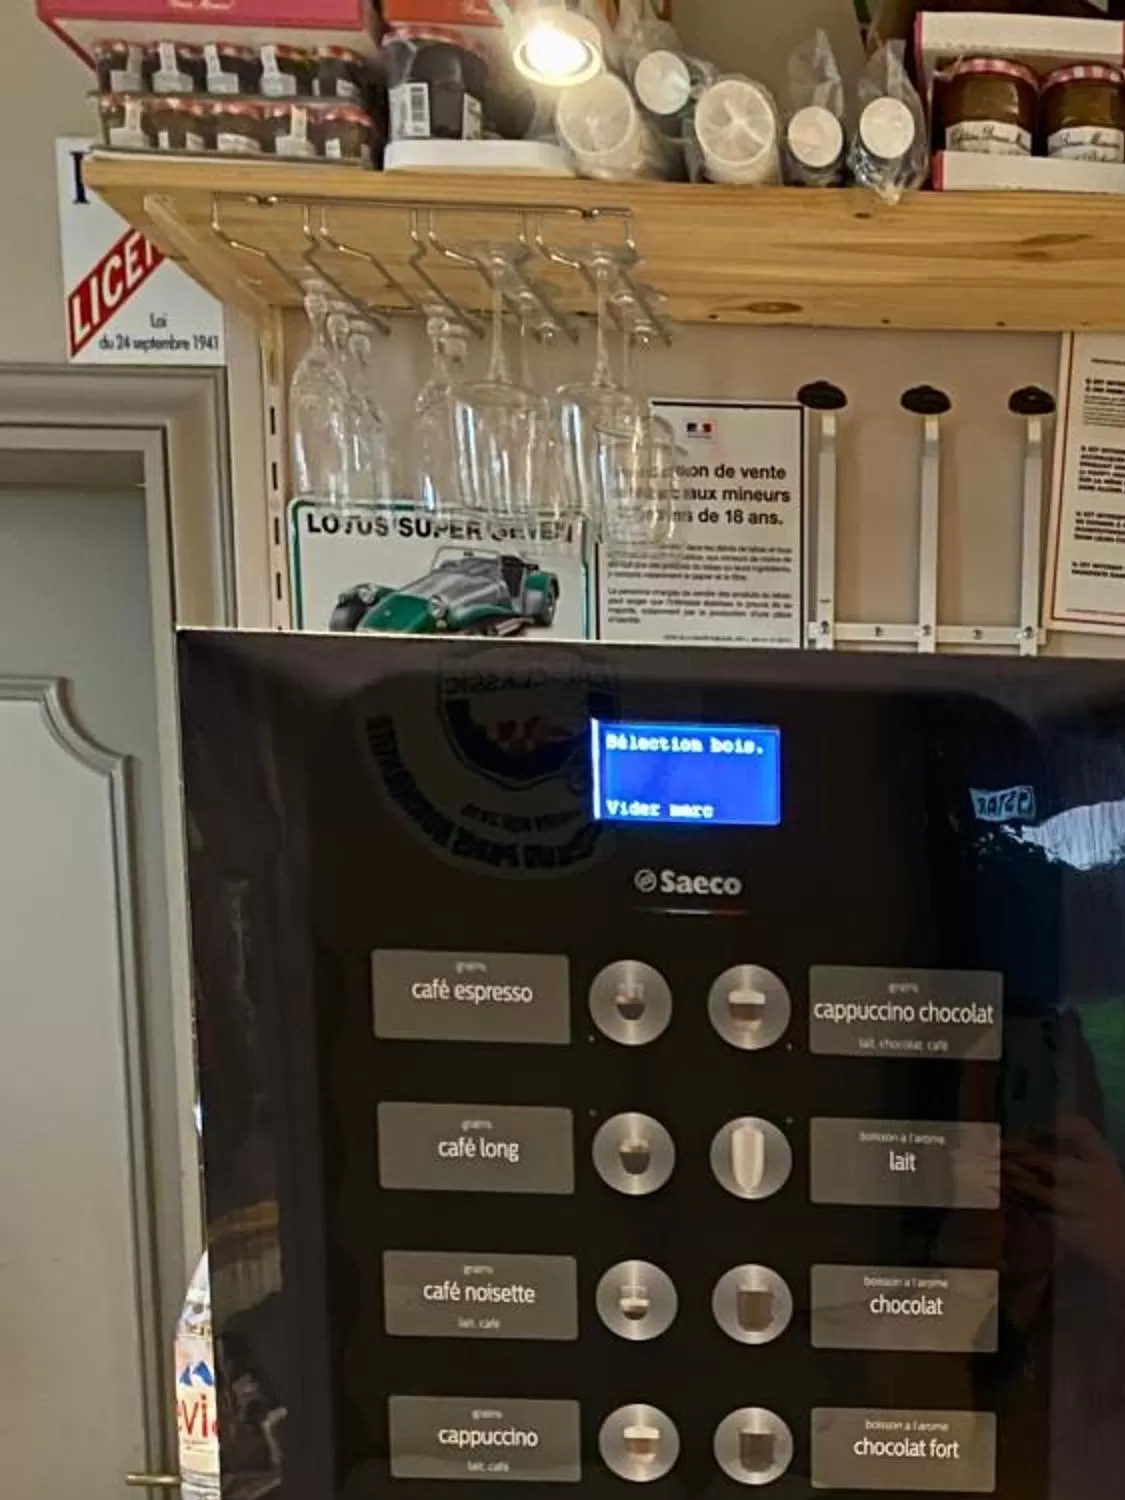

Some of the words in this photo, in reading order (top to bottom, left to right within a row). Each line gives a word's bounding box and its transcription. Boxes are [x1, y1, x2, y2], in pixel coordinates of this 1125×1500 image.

[150, 313, 168, 329] Loi
[99, 334, 115, 350] du
[116, 334, 130, 350] 24
[133, 334, 190, 353] septembre
[193, 333, 219, 350] 1941
[715, 464, 735, 479] de
[740, 466, 787, 480] vente
[722, 486, 791, 503] mineurs
[698, 508, 719, 523] de
[725, 509, 743, 524] 18
[747, 511, 784, 525] ans.
[307, 514, 389, 537] LOTUS
[399, 516, 483, 541] SUPER
[606, 799, 661, 816] Vider
[659, 869, 743, 895] Saeco
[411, 978, 450, 1000] café
[454, 983, 533, 1005] espresso
[813, 1001, 915, 1024] cappuccino
[919, 1001, 994, 1025] chocolat
[438, 1136, 476, 1158] café
[479, 1137, 520, 1163] long
[889, 1151, 917, 1172] lait
[423, 1281, 461, 1301] café
[465, 1283, 536, 1304] noisette
[869, 1294, 944, 1316] chocolat
[437, 1428, 539, 1448] cappuccino
[853, 1436, 927, 1458] chocolat
[929, 1438, 960, 1460] fort
